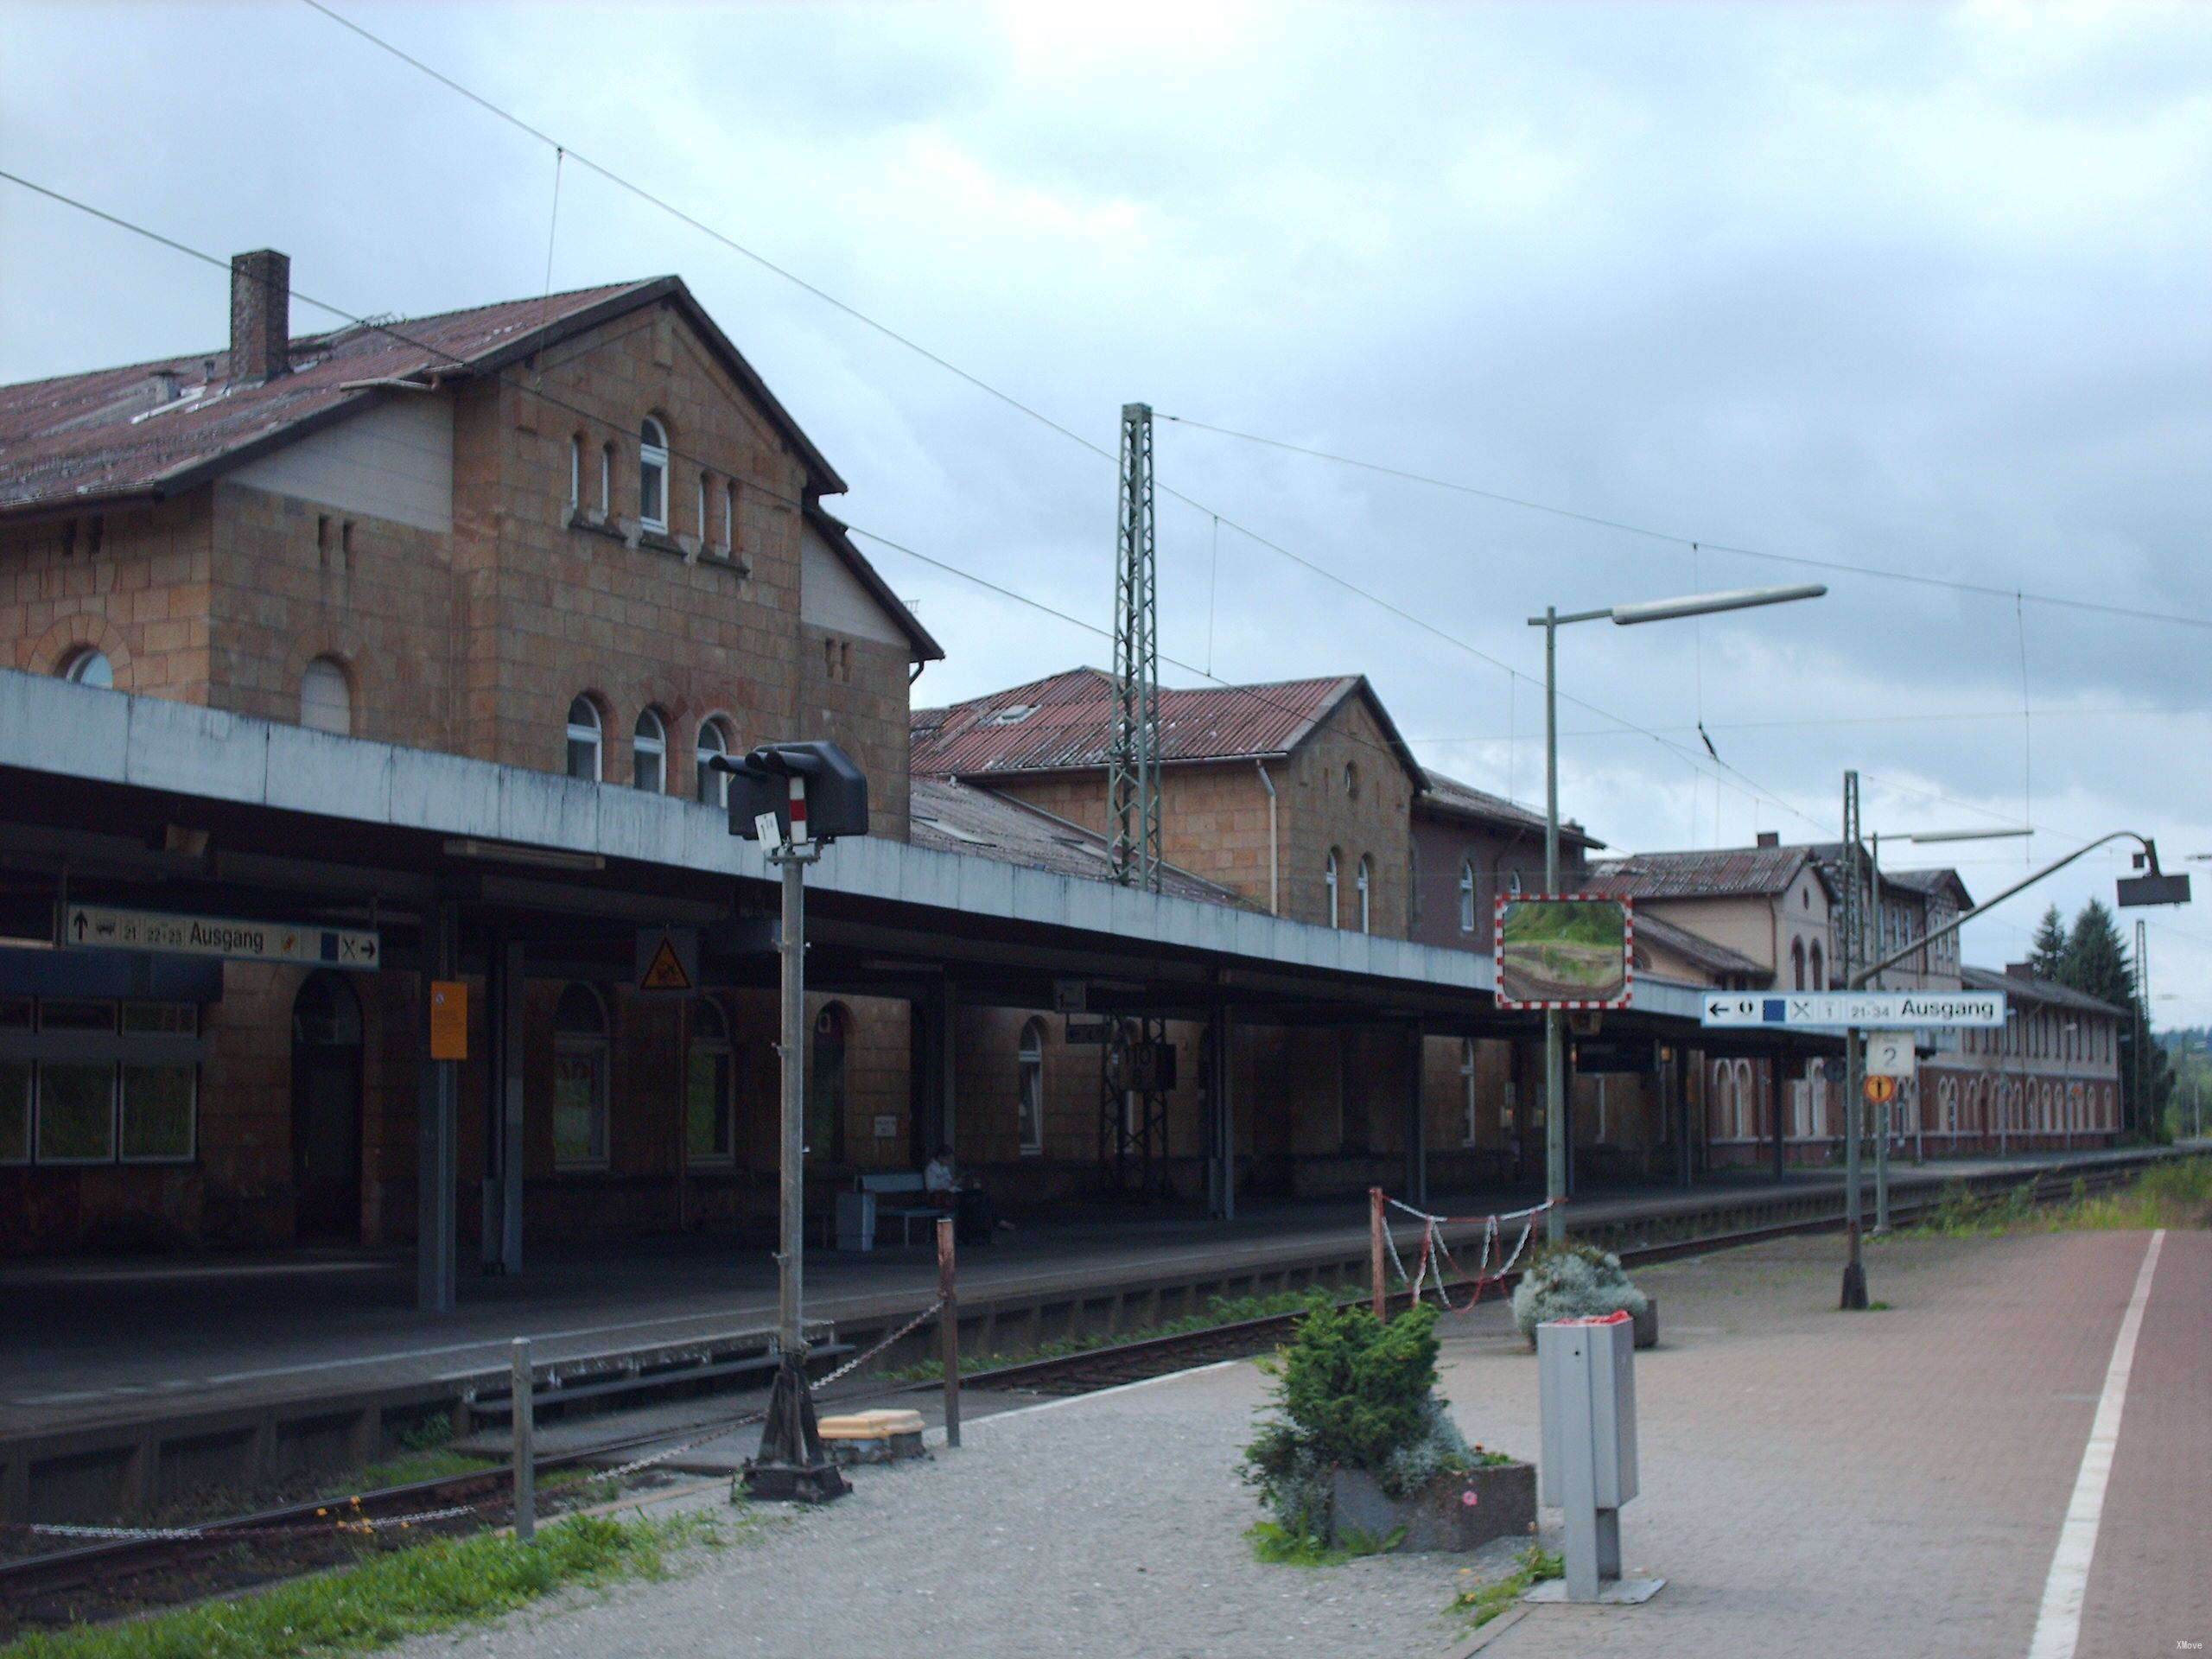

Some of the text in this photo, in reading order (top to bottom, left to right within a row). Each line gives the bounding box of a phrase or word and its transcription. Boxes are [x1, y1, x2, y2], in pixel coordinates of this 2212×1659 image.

[124, 925, 136, 940] 21
[190, 921, 264, 953] Ausgang
[1902, 998, 1993, 1019] Ausgang
[1883, 1046, 1897, 1067] 2
